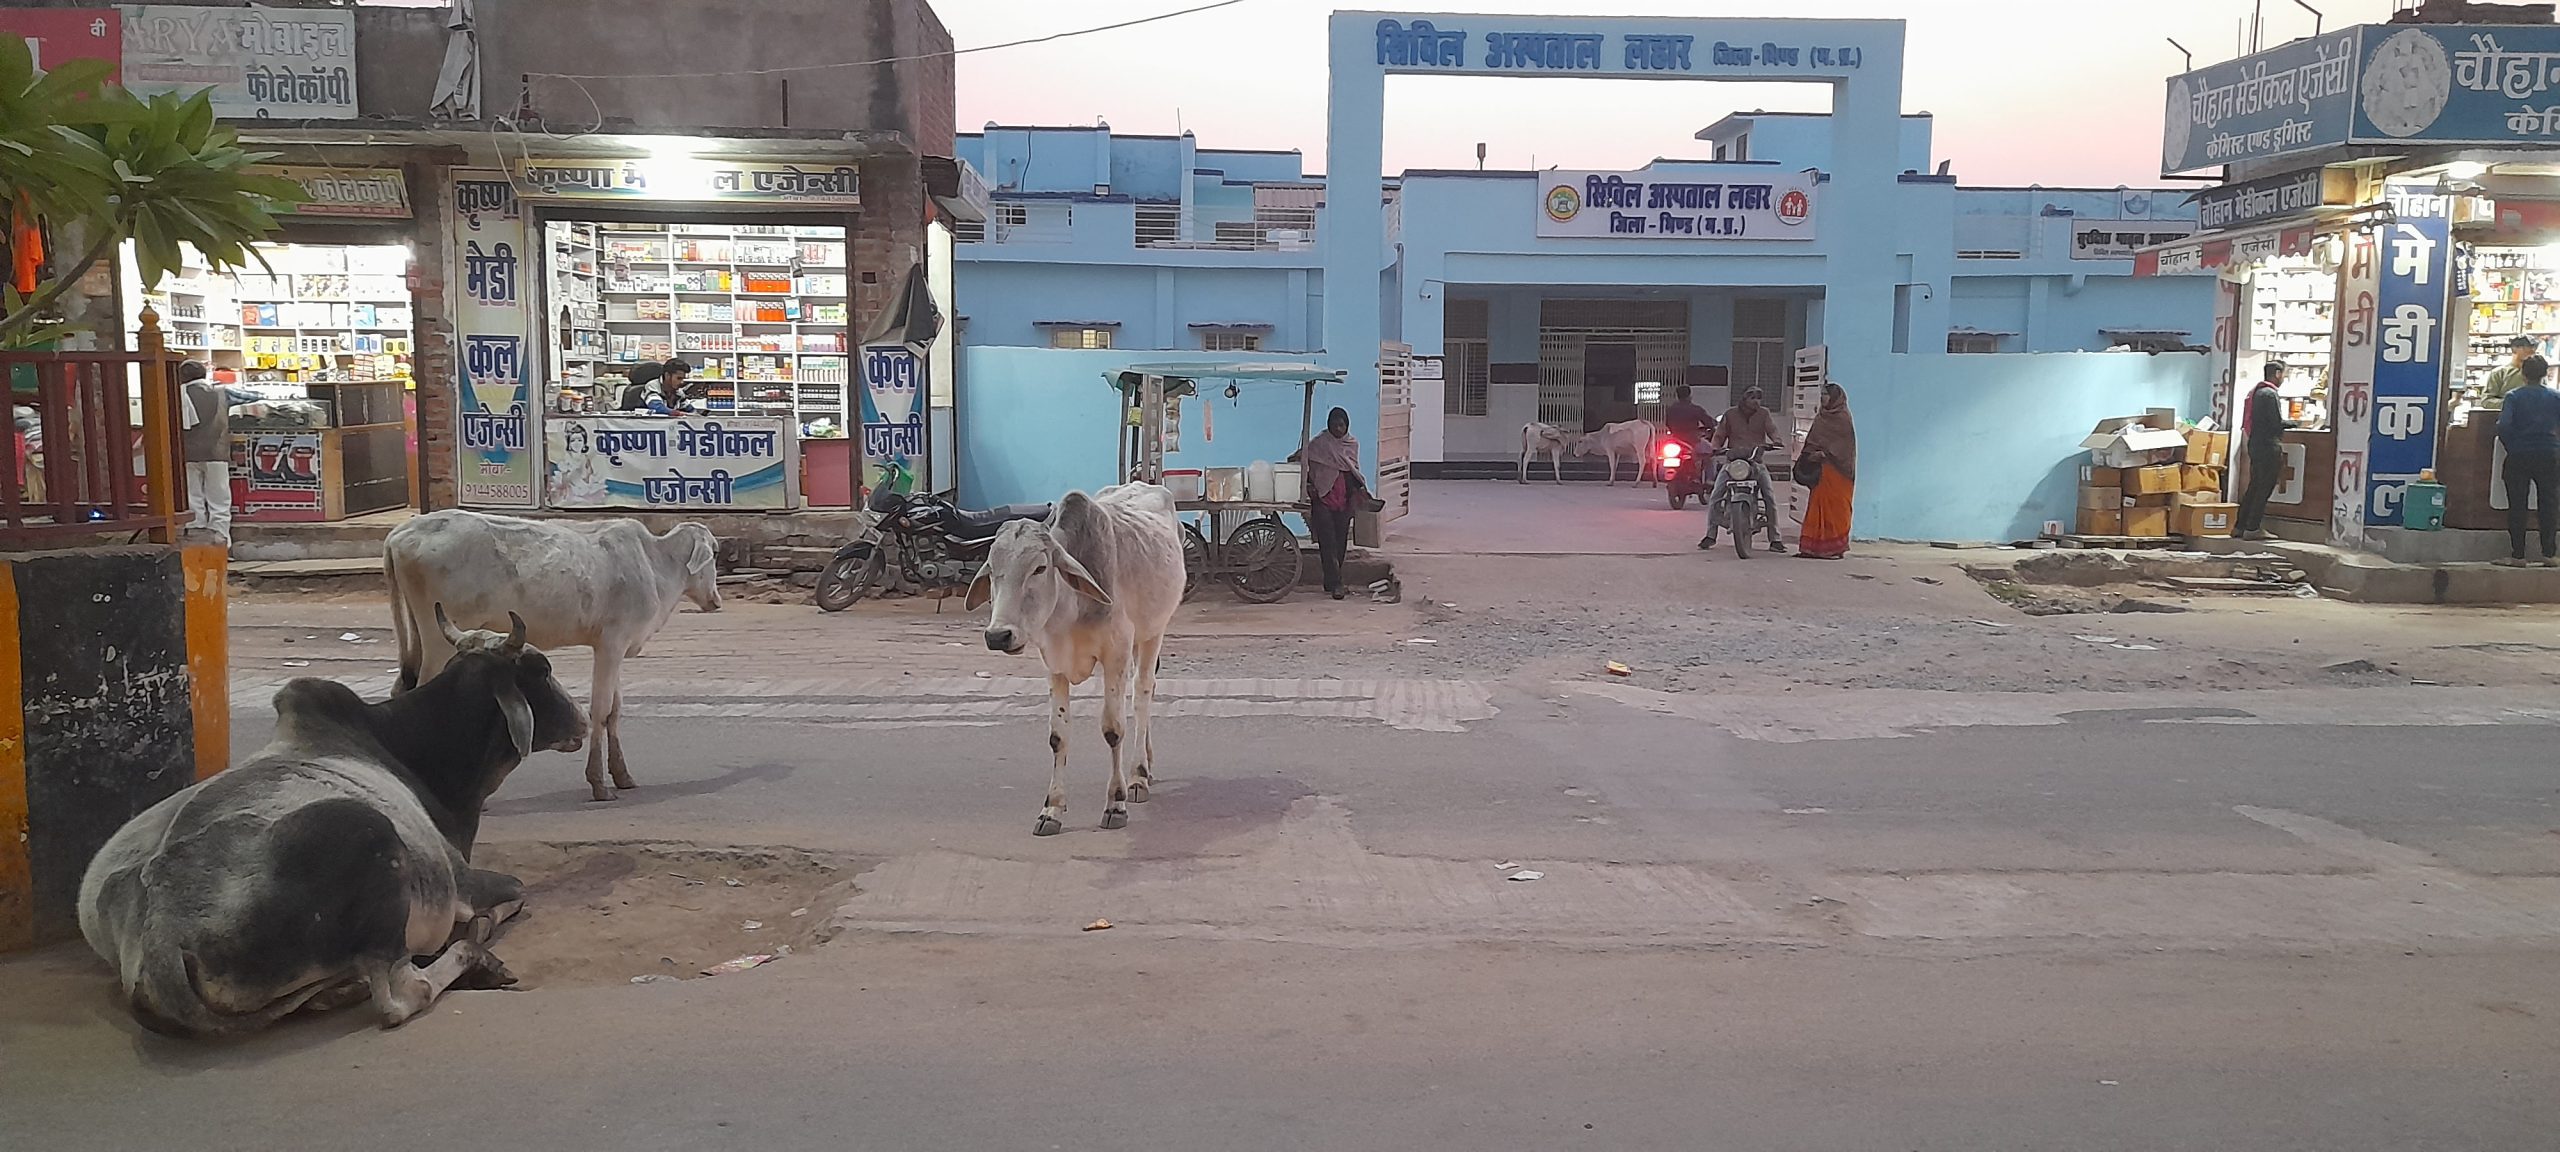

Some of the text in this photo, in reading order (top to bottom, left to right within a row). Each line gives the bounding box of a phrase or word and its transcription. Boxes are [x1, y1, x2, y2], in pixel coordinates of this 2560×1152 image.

[237, 13, 348, 61] मोबाइल
[1485, 32, 1604, 69] अस्पताल
[1624, 35, 1694, 70] लहार
[247, 65, 351, 104] फोटोकॉपी
[2192, 77, 2235, 129] चौहान
[2236, 60, 2298, 116] मेडीकल
[2206, 132, 2246, 159] केमिस्ट
[525, 167, 614, 196] कृष्णा
[751, 166, 859, 194] एजेन्सी
[1648, 184, 1723, 209] अस्पताल
[1728, 185, 1772, 209] लहार
[465, 240, 518, 301] मेडी
[466, 334, 520, 379] कल
[866, 345, 916, 389] कल
[462, 402, 526, 448] एजेन्सी
[594, 421, 776, 466] कृष्णा मेडीकल
[864, 412, 923, 456] एजेन्सी
[465, 483, 528, 498] 9144588005
[643, 468, 733, 504] एजेन्सी
